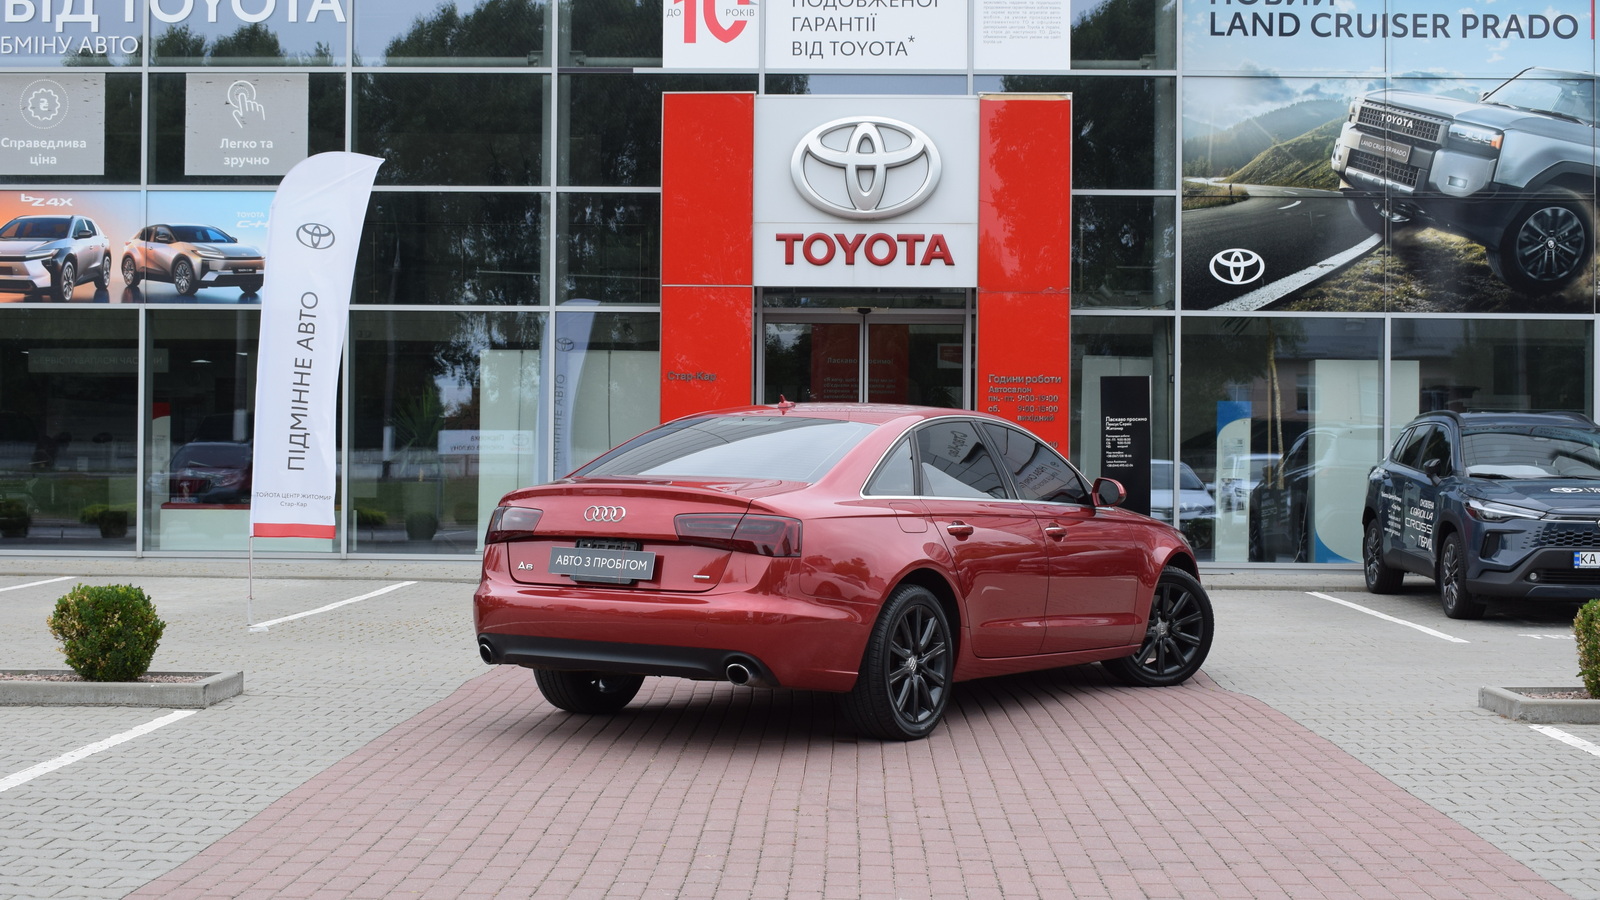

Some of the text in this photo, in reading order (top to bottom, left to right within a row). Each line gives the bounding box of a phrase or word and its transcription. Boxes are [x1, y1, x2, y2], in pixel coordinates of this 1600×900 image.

[666, 8, 682, 18] ДО
[725, 8, 755, 17] РОКІВ
[791, 13, 876, 32] ГАРАНТІЇ
[1210, 12, 1579, 40] LAND CRUISER PRADO
[79, 36, 139, 54] АВТО
[791, 41, 824, 59] ВІД
[1381, 114, 1413, 128] TOYOTA
[1, 138, 87, 151] Справедлива
[220, 139, 273, 150] Легко та
[1360, 140, 1373, 148] LAND
[30, 154, 57, 167] ціна
[223, 155, 270, 168] зручно
[236, 211, 265, 219] TOYOTA
[776, 232, 955, 267] TOYOTA
[287, 291, 319, 471] ПІДМІННЕ АВТО
[667, 371, 717, 382] Стар-Кар
[988, 374, 1061, 385] Години роботи
[1017, 414, 1054, 422] вихідний
[1410, 506, 1433, 521] COROLLA
[1405, 517, 1433, 534] CROSS
[517, 561, 534, 570] A6
[555, 555, 648, 571] АВТО З ПРОБІГОМ
[1580, 553, 1597, 565] KA
